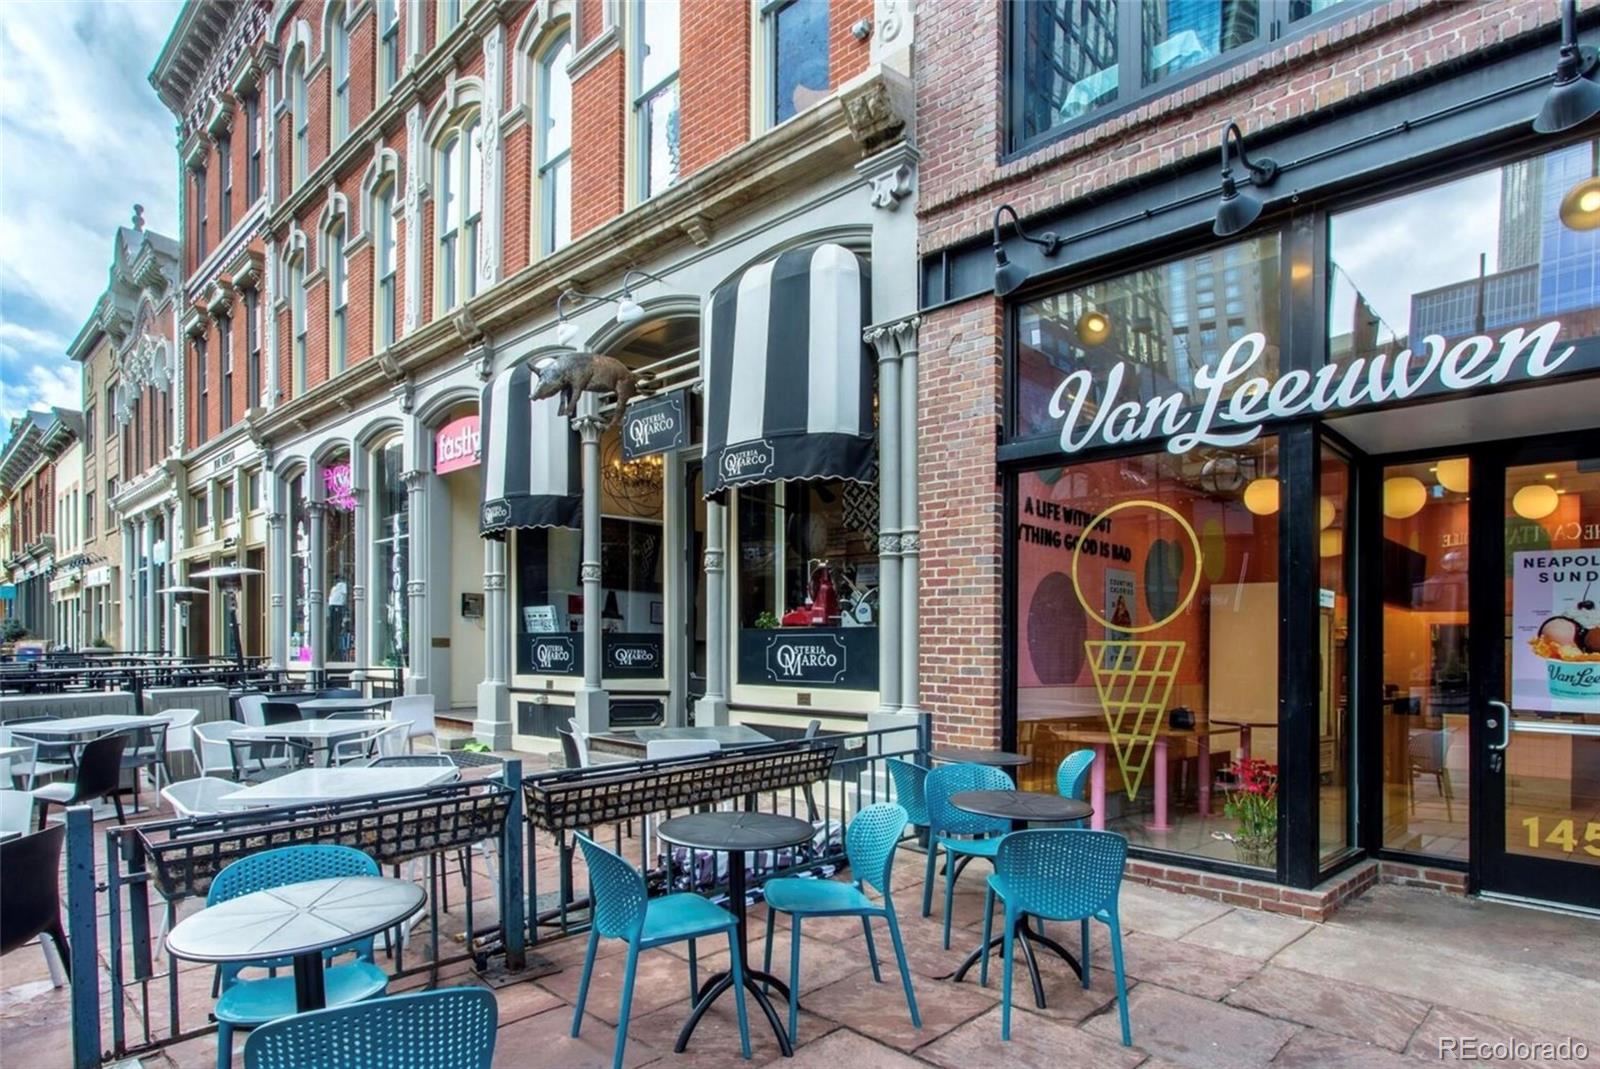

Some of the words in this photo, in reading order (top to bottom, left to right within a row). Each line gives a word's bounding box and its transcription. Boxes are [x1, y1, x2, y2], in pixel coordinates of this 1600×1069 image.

[1049, 361, 1192, 453] Van
[1167, 320, 1575, 454] Leeuwen
[630, 412, 665, 441] OSTERIA
[635, 418, 674, 447] MARCO
[728, 454, 766, 476] MARCO
[1025, 497, 1034, 515] A
[1036, 500, 1060, 521] LIFE
[1064, 534, 1097, 556] GOOD
[1100, 541, 1109, 559] IS
[1111, 544, 1132, 563] BAD
[1539, 571, 1599, 583] SUND
[541, 651, 569, 668] MARCO
[776, 645, 826, 668] OSTERIA
[783, 652, 837, 676] MARCO
[1547, 664, 1575, 682] Van
